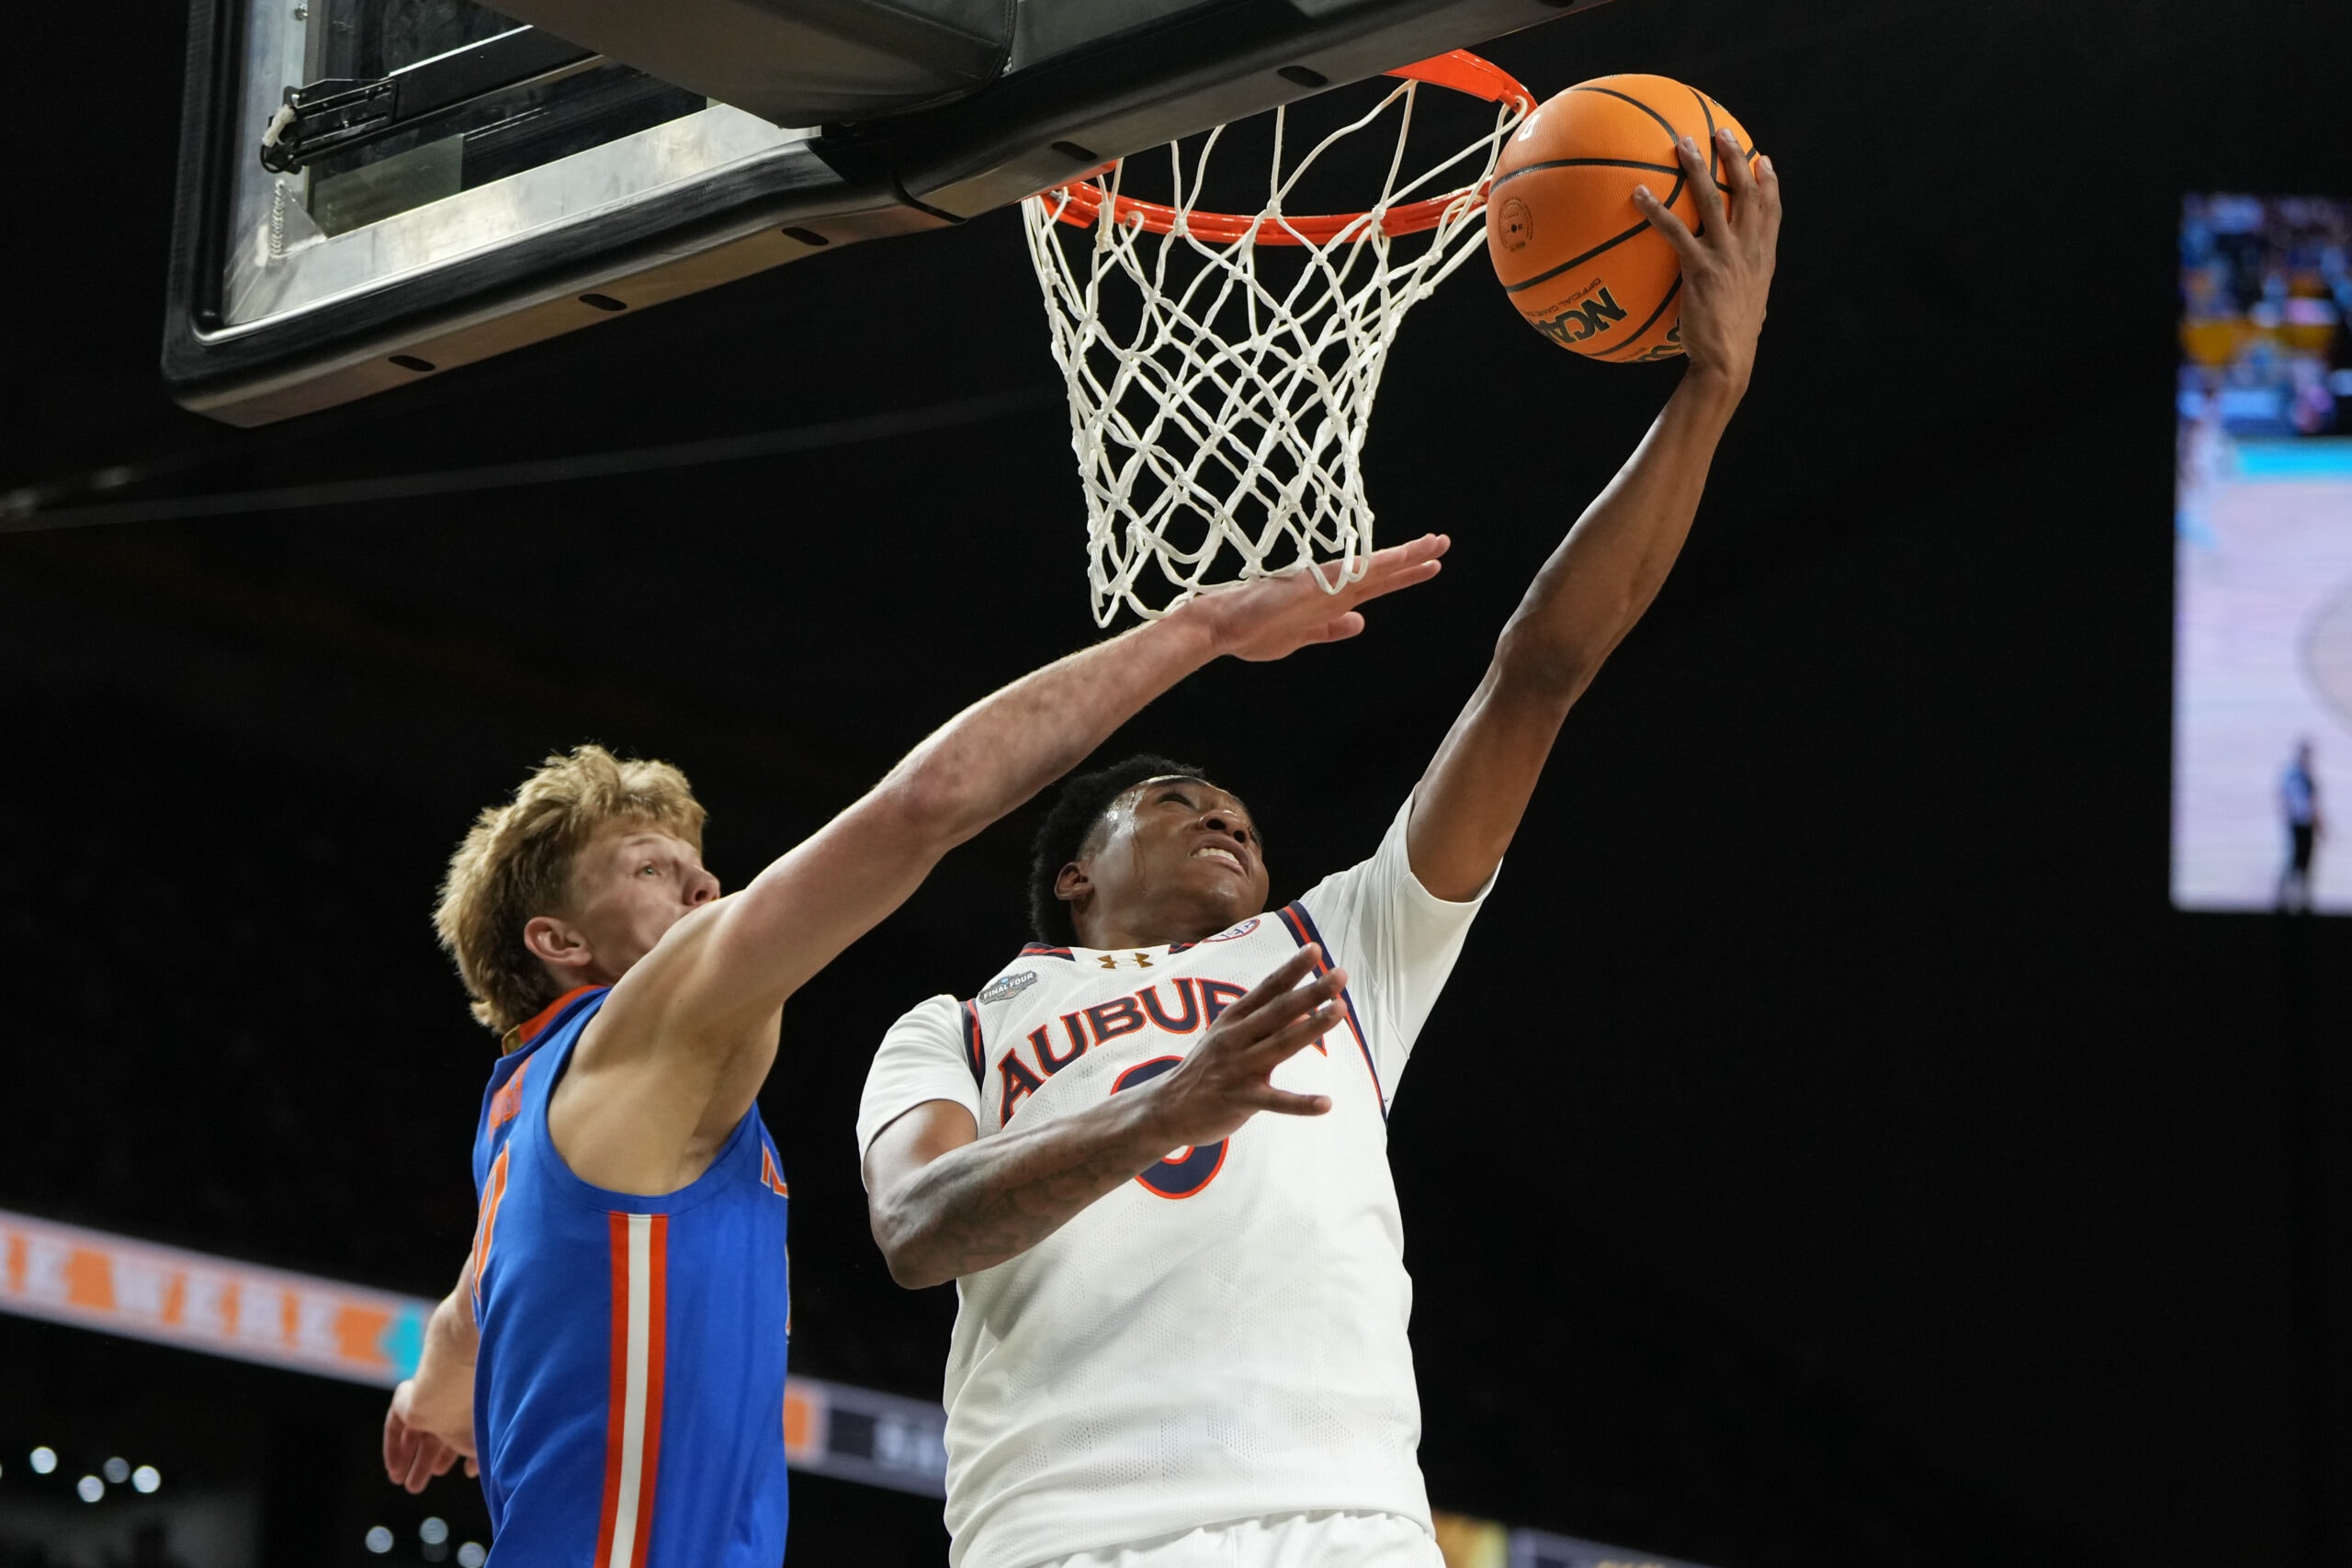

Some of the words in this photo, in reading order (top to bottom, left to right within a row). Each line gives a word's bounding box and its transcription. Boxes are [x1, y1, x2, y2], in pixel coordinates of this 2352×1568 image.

[983, 984, 1009, 999] FINAL
[1010, 972, 1034, 987] FOUR
[997, 976, 1328, 1131] AUBUR
